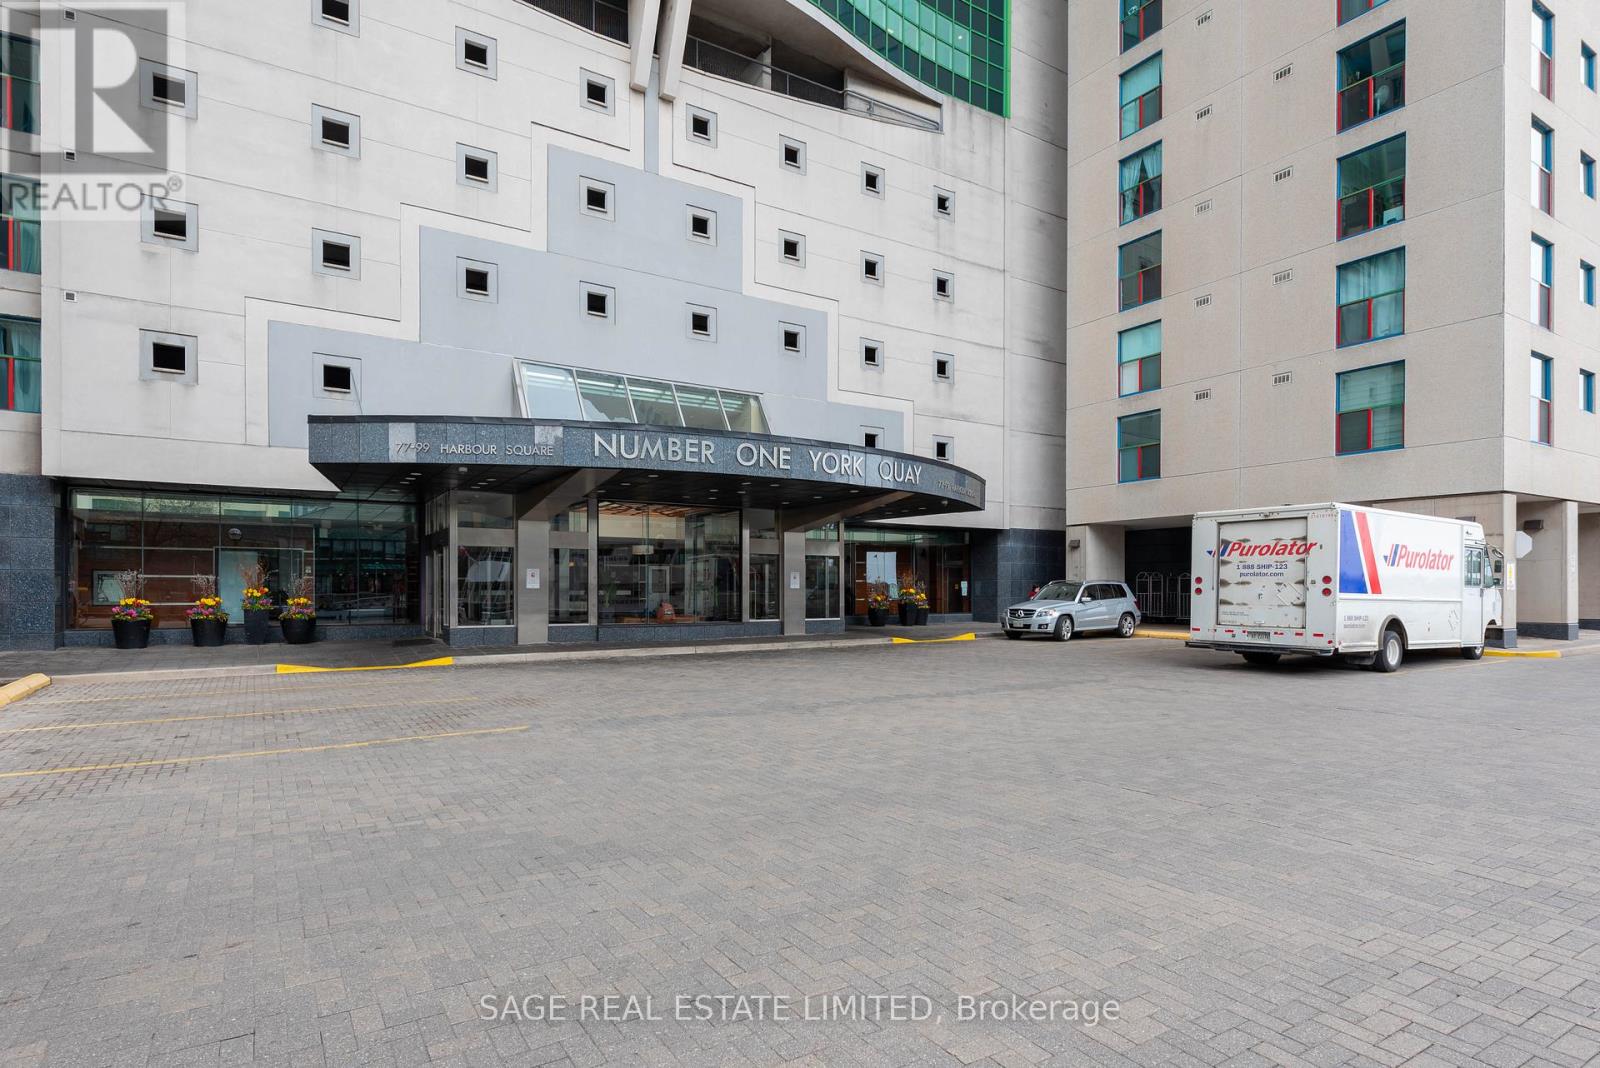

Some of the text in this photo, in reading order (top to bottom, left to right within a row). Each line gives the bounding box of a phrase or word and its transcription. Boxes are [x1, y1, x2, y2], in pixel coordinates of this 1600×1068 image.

[395, 442, 554, 457] 77-99 HARBOUR SQUARE
[594, 432, 922, 485] NUMBER ONE YORK QUAY
[1227, 540, 1318, 558] Purolator
[1396, 544, 1455, 571] Purolator
